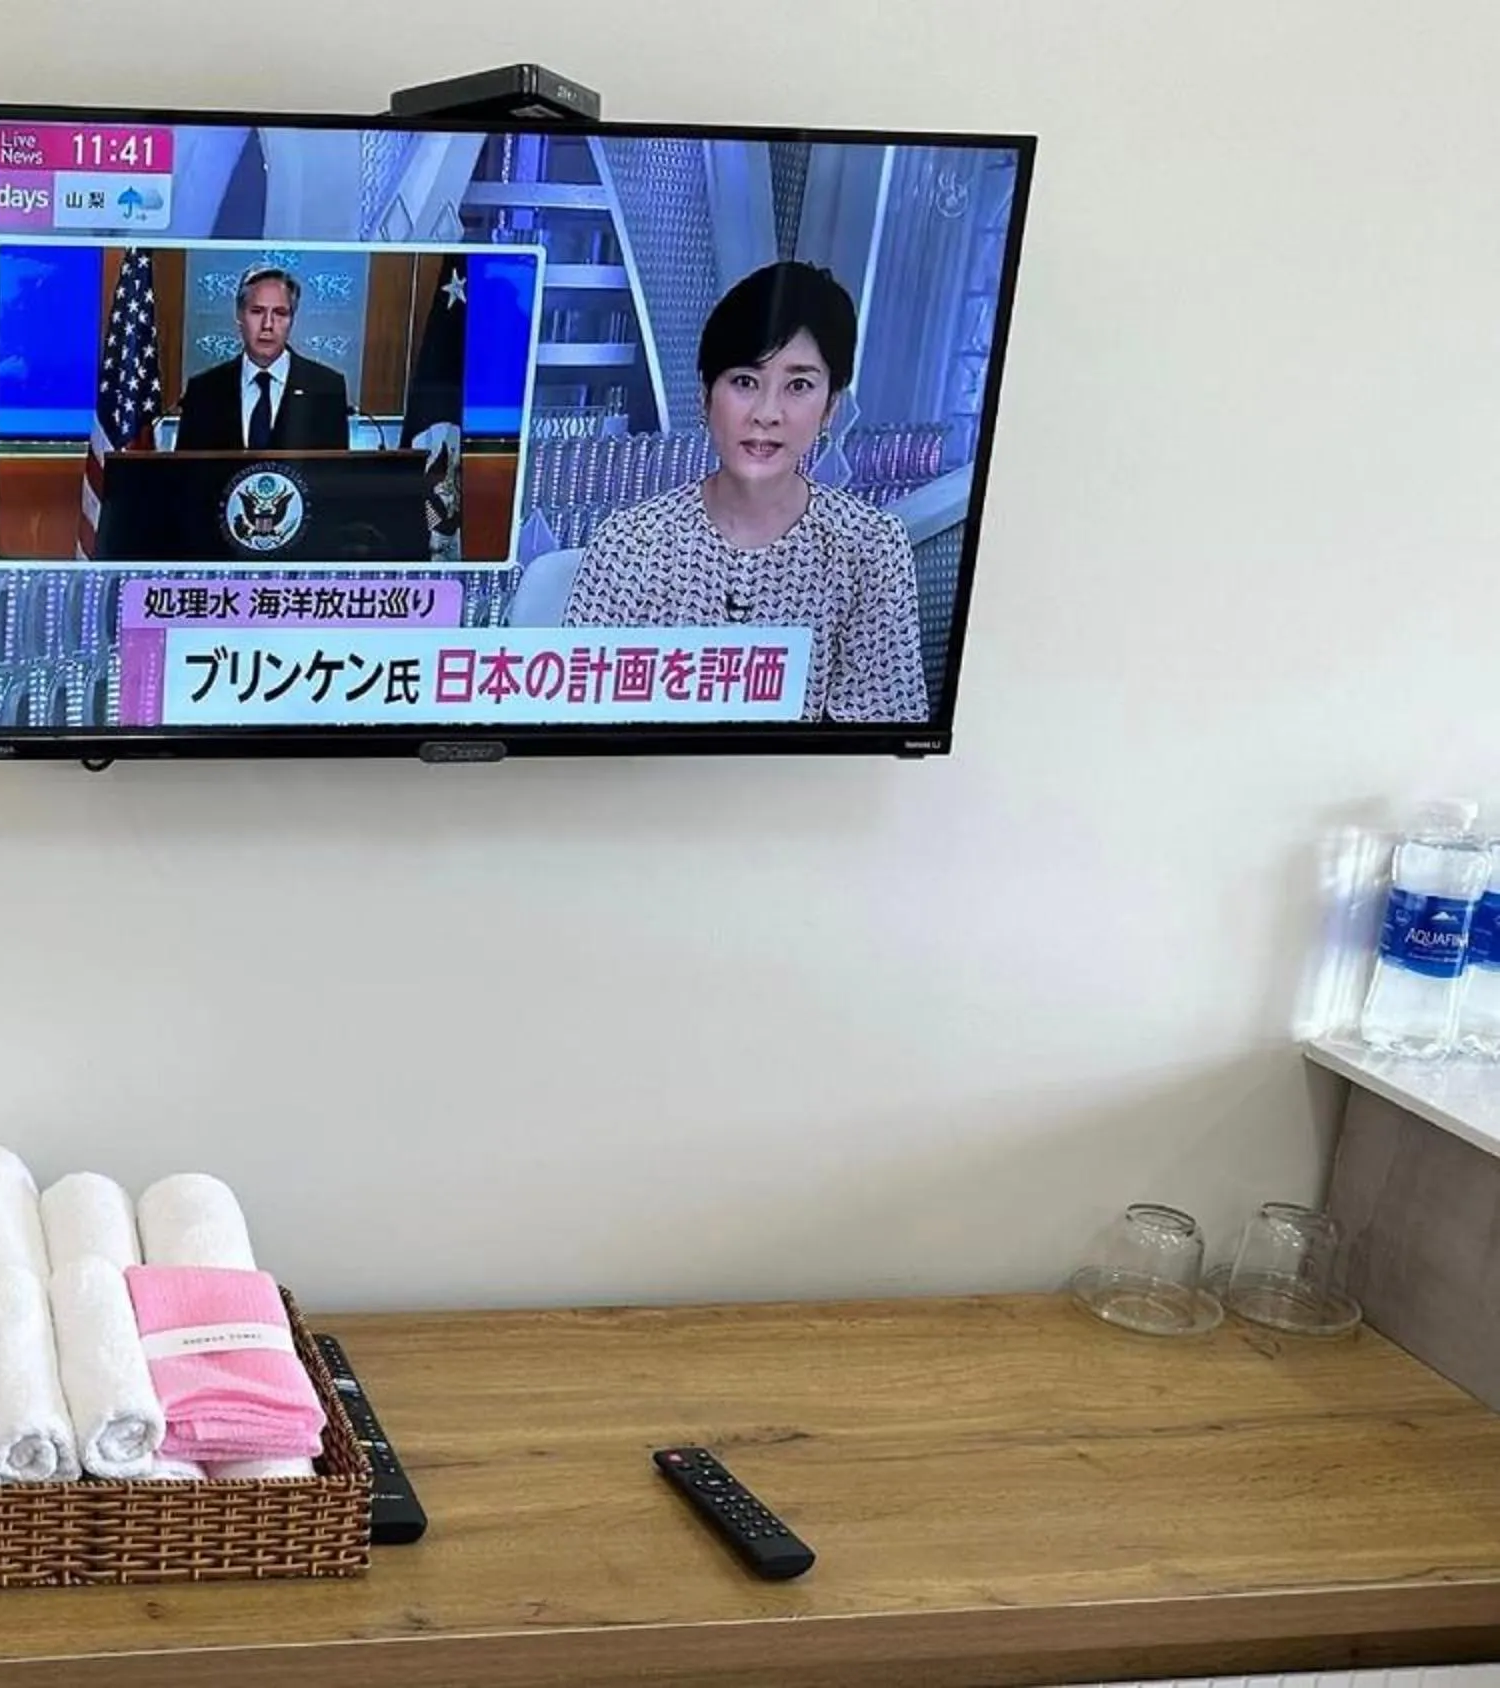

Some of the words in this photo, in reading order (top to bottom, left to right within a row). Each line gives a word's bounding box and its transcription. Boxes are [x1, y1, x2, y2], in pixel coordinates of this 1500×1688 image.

[1, 131, 37, 148] Live
[73, 133, 153, 166] 11:41
[0, 149, 43, 165] News
[144, 586, 241, 620] 処理水
[249, 586, 436, 620] 海洋放出巡り
[185, 645, 421, 704] ブリンケン氏
[435, 645, 789, 704] 日本の計画を評価
